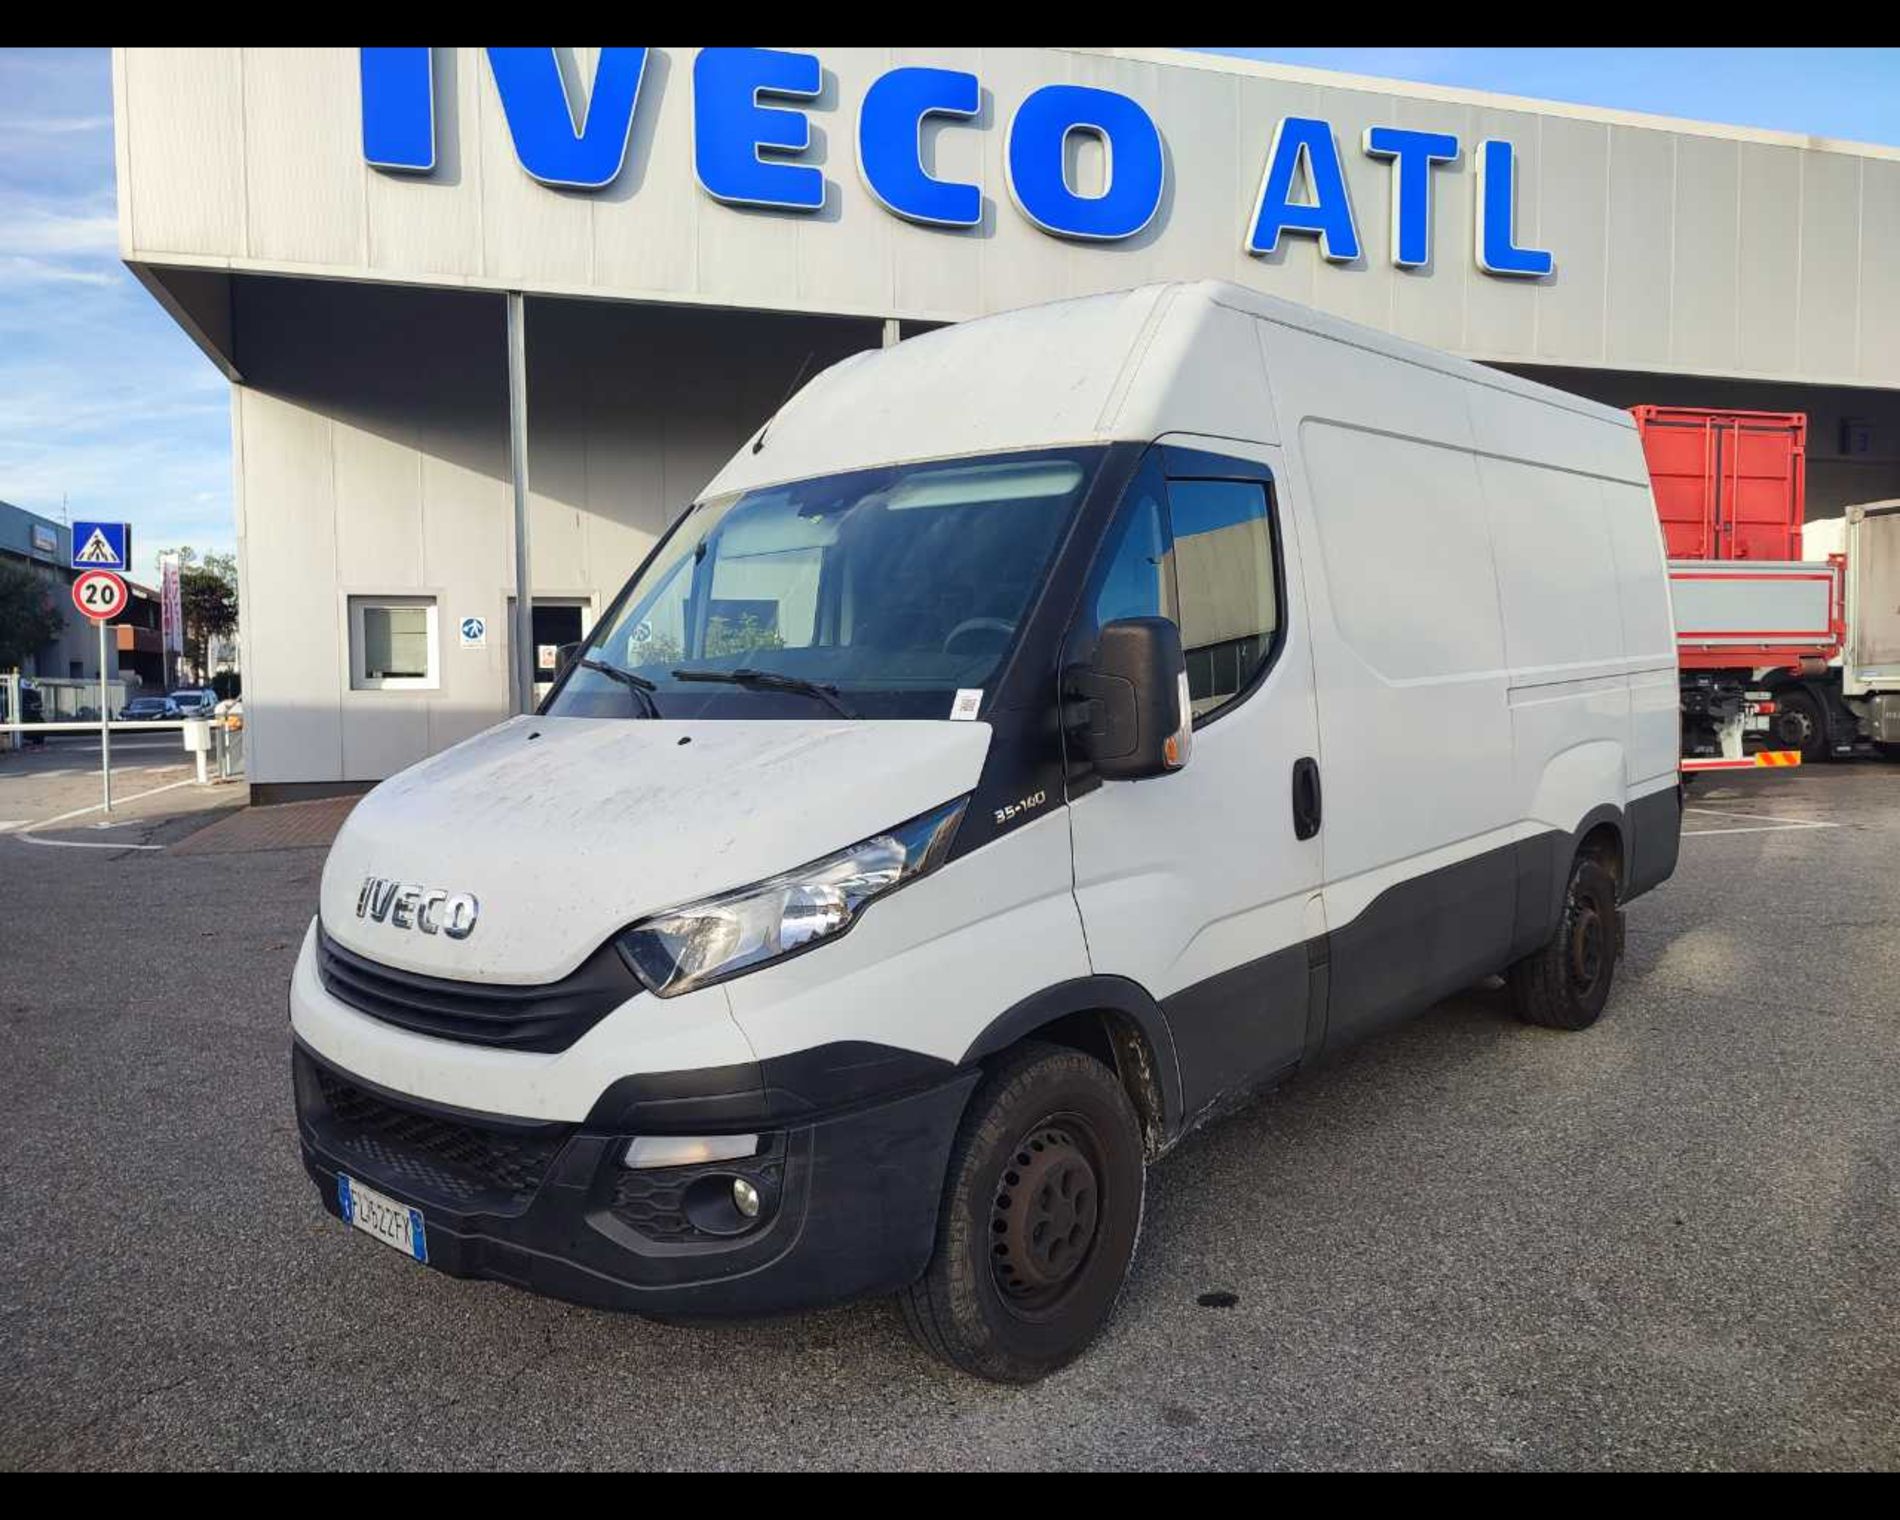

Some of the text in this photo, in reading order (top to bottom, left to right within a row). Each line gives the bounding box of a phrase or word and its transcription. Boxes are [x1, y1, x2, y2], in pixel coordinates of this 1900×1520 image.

[359, 47, 1554, 275] IVECO ATL
[85, 583, 115, 605] 20
[994, 790, 1046, 824] 35-140
[356, 876, 479, 940] IVECO
